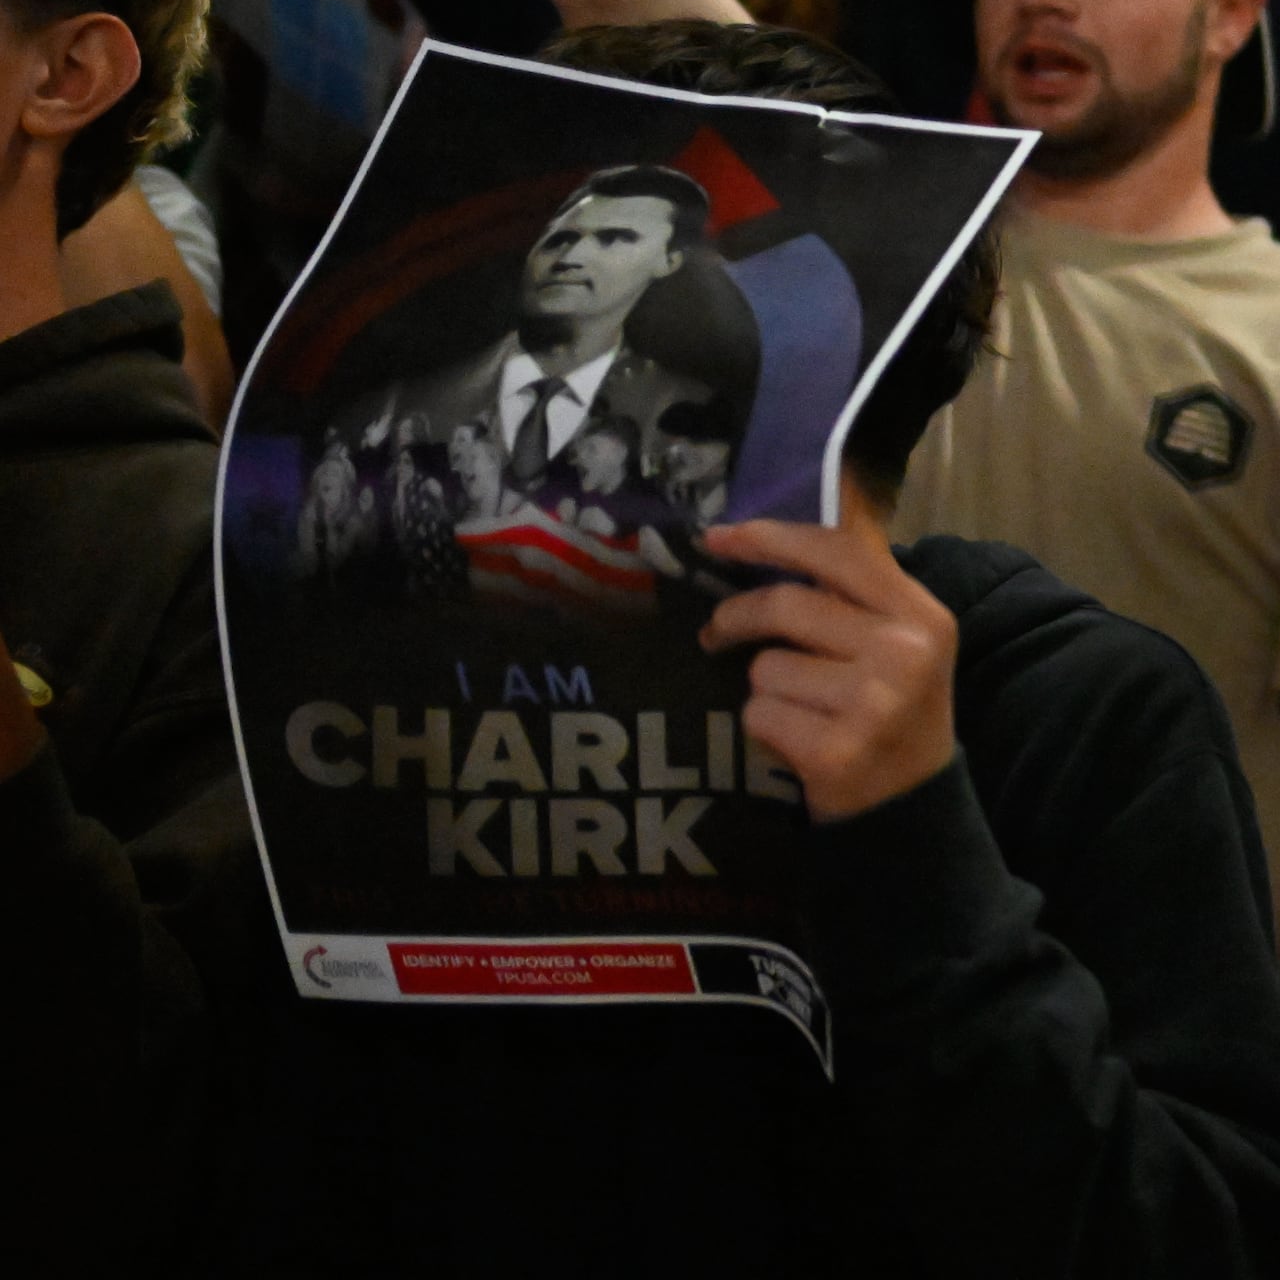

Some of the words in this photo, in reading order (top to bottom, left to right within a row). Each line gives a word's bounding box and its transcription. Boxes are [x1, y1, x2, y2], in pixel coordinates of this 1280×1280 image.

[455, 659, 472, 703] I
[502, 662, 596, 706] AM
[425, 795, 720, 878] KIRK
[401, 954, 476, 970] IDENTIFY
[491, 954, 576, 970] EMPOWER
[589, 954, 678, 970] ORGANIZE
[494, 969, 593, 986] TPUSA.COM
